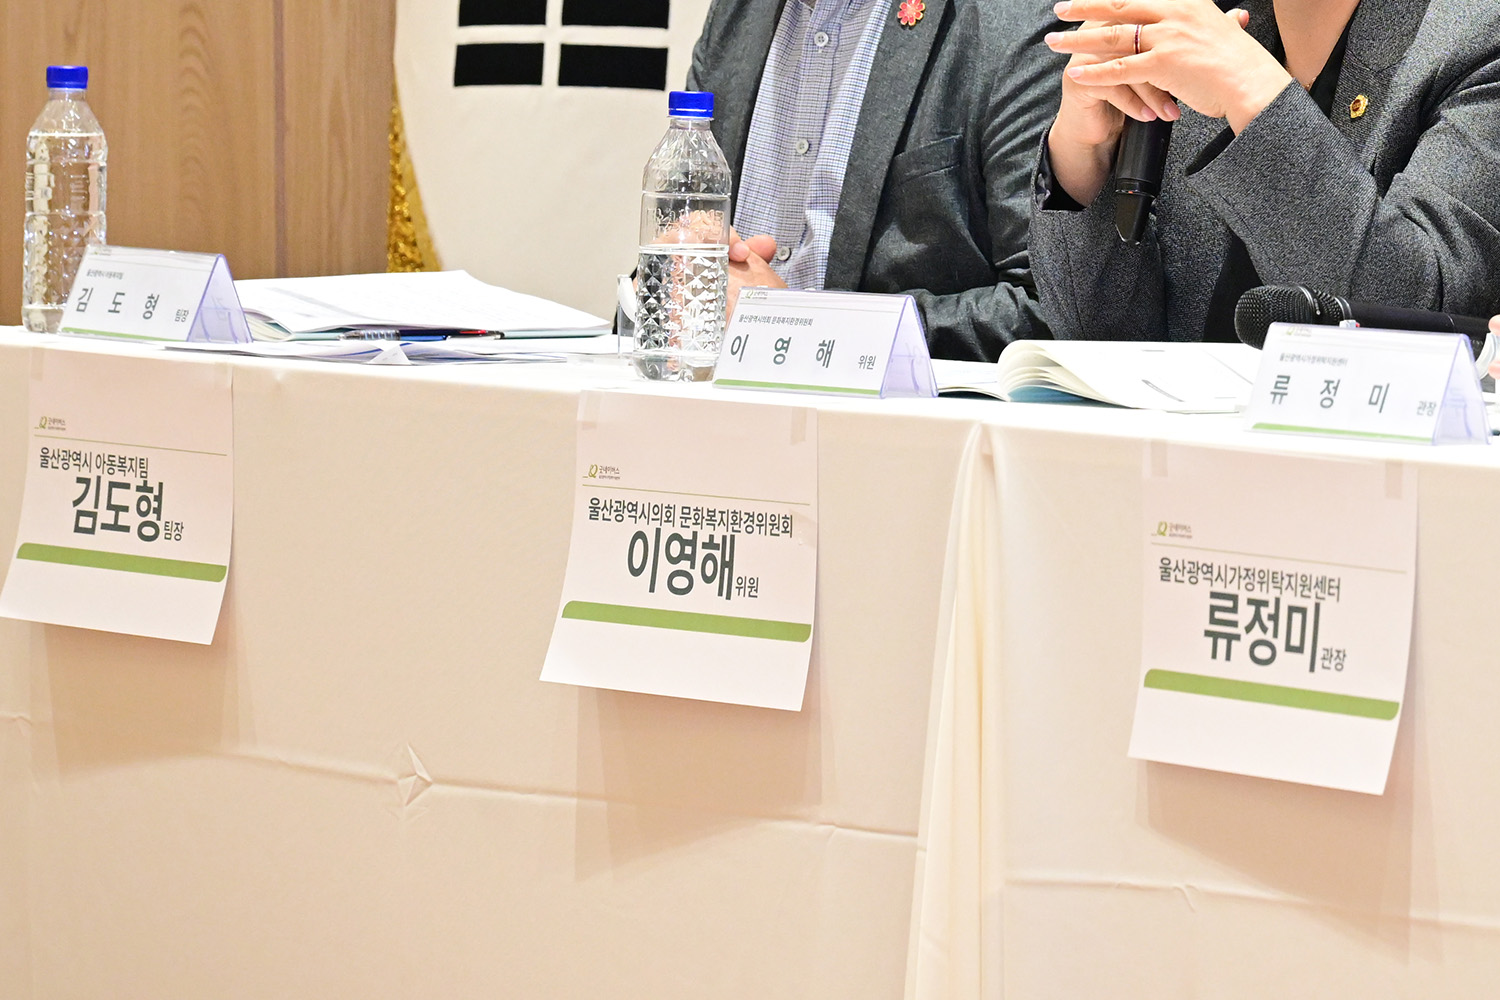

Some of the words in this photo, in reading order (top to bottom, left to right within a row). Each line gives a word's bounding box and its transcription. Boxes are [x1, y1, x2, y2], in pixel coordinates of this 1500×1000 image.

[857, 354, 877, 371] 위원
[1416, 399, 1437, 417] 관장
[39, 446, 92, 473] 울산광역시
[95, 452, 149, 479] 아동복지팀
[72, 475, 164, 543] 김도형
[163, 520, 185, 542] 팀장
[588, 496, 676, 528] 울산광역시의회
[679, 505, 794, 539] 문화복지환경위원회
[627, 527, 735, 601] 이영해
[735, 575, 760, 599] 위원
[1158, 556, 1341, 603] 울산광역시가정위탁지원센터
[1203, 591, 1321, 674] 류정미
[1320, 646, 1347, 673] 관장
